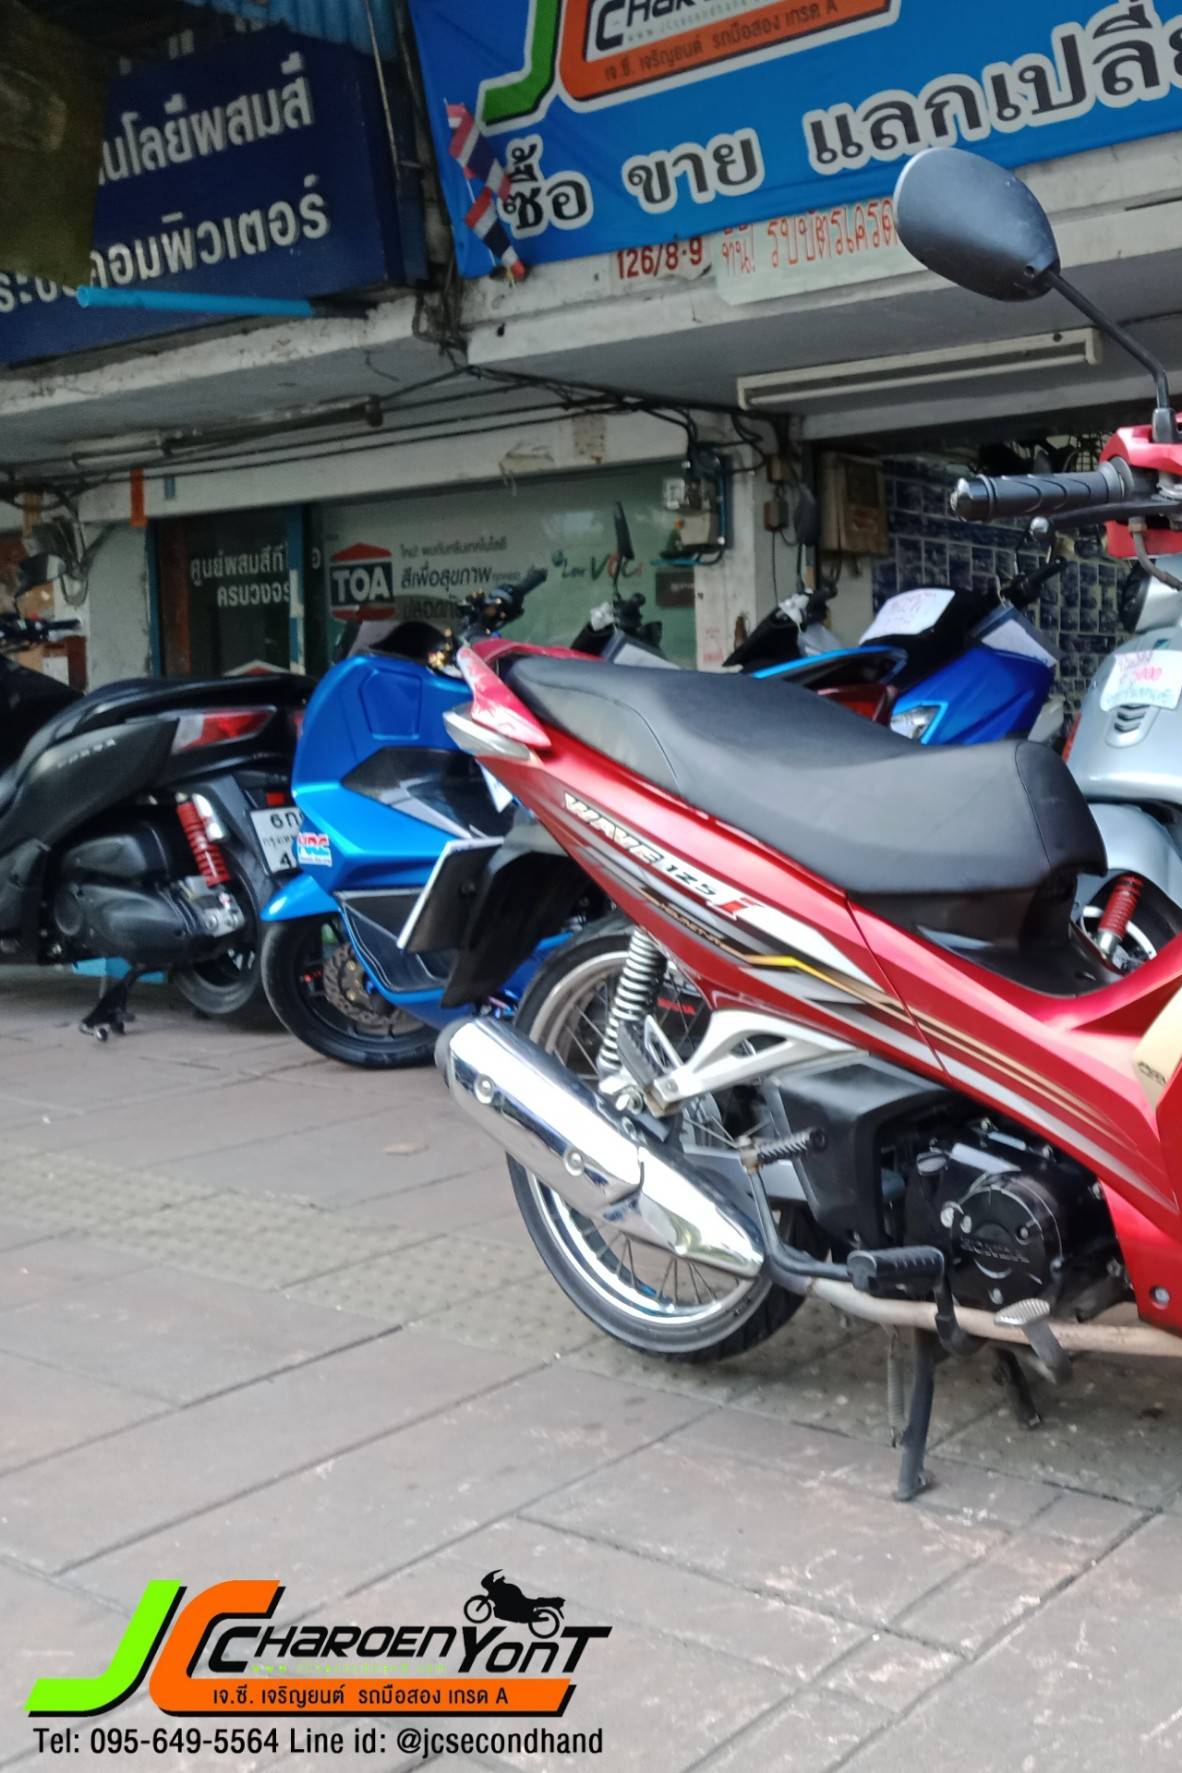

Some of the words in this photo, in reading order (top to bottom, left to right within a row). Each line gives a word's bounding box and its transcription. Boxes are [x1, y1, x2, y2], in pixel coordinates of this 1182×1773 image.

[825, 2, 839, 14] A
[503, 141, 587, 232] ซื้อ
[627, 137, 759, 206] ขาย
[332, 566, 390, 603] TOA
[401, 560, 492, 591] สีเพื่อสุขภาพ
[563, 792, 666, 865] WAVE
